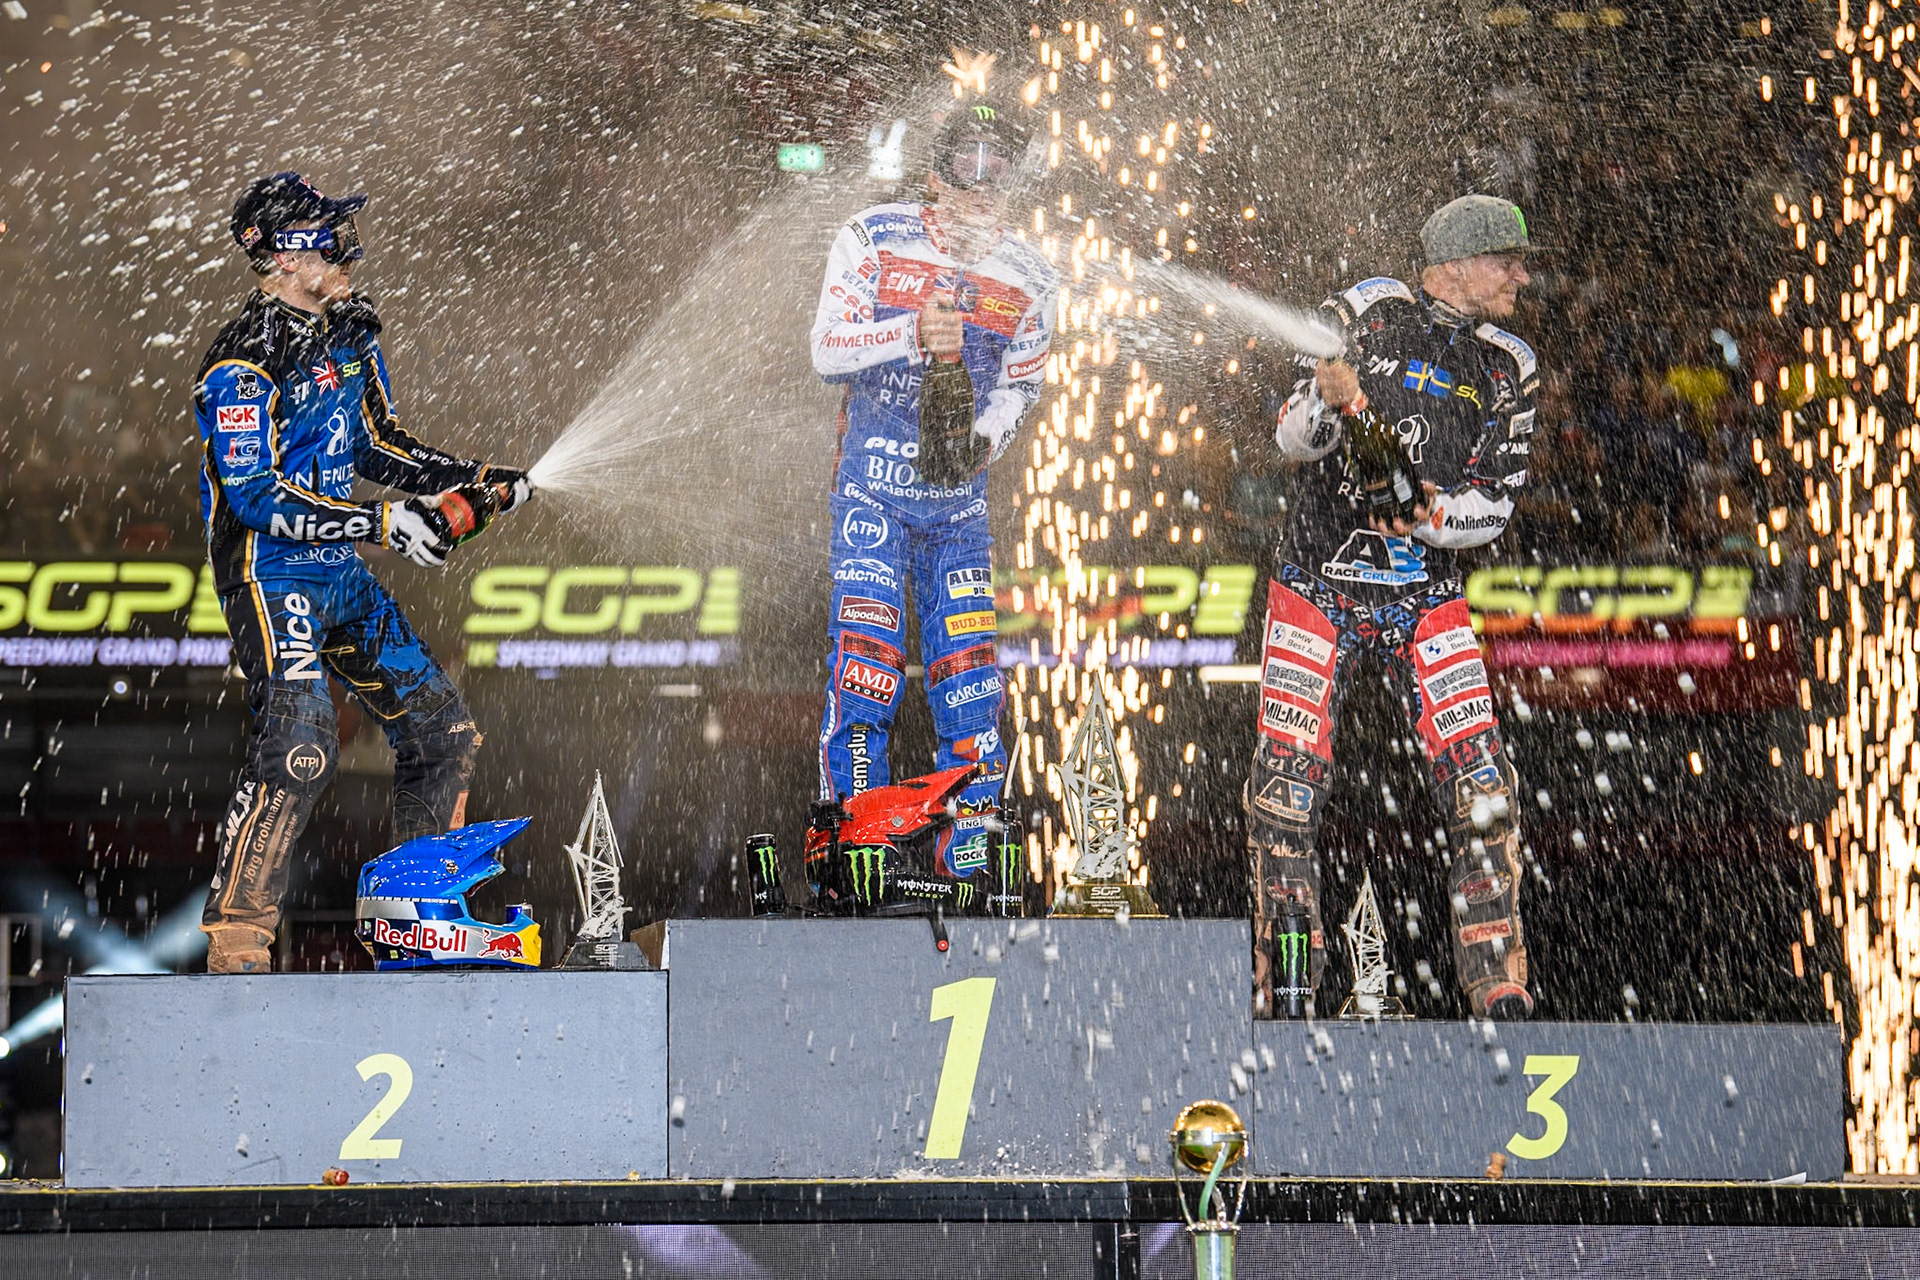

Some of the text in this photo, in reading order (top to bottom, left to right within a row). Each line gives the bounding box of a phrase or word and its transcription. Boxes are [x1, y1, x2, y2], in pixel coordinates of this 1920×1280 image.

[219, 407, 255, 423] NGK
[410, 448, 429, 460] KW
[866, 455, 915, 487] BIO
[270, 512, 372, 541] Nice
[848, 520, 882, 538] ATPI
[834, 569, 899, 591] automax
[1324, 566, 1361, 578] RACE
[464, 565, 701, 635] SGP
[843, 608, 892, 626] Alpodach
[279, 592, 322, 681] Nice
[1290, 630, 1314, 645] BMW
[1287, 640, 1326, 661] Best Auto
[847, 664, 896, 694] AMD
[845, 681, 890, 701] GROUP
[292, 756, 320, 769] ATPI
[243, 788, 286, 884] Jörg Grohmann
[954, 851, 983, 864] ROCK
[897, 879, 953, 894] MONSTER
[904, 891, 945, 900] ENERGY
[1090, 886, 1122, 896] SGP
[374, 919, 467, 953] Red Bull
[924, 976, 997, 1160] 1
[338, 1052, 415, 1161] 2
[1505, 1054, 1580, 1160] 3
